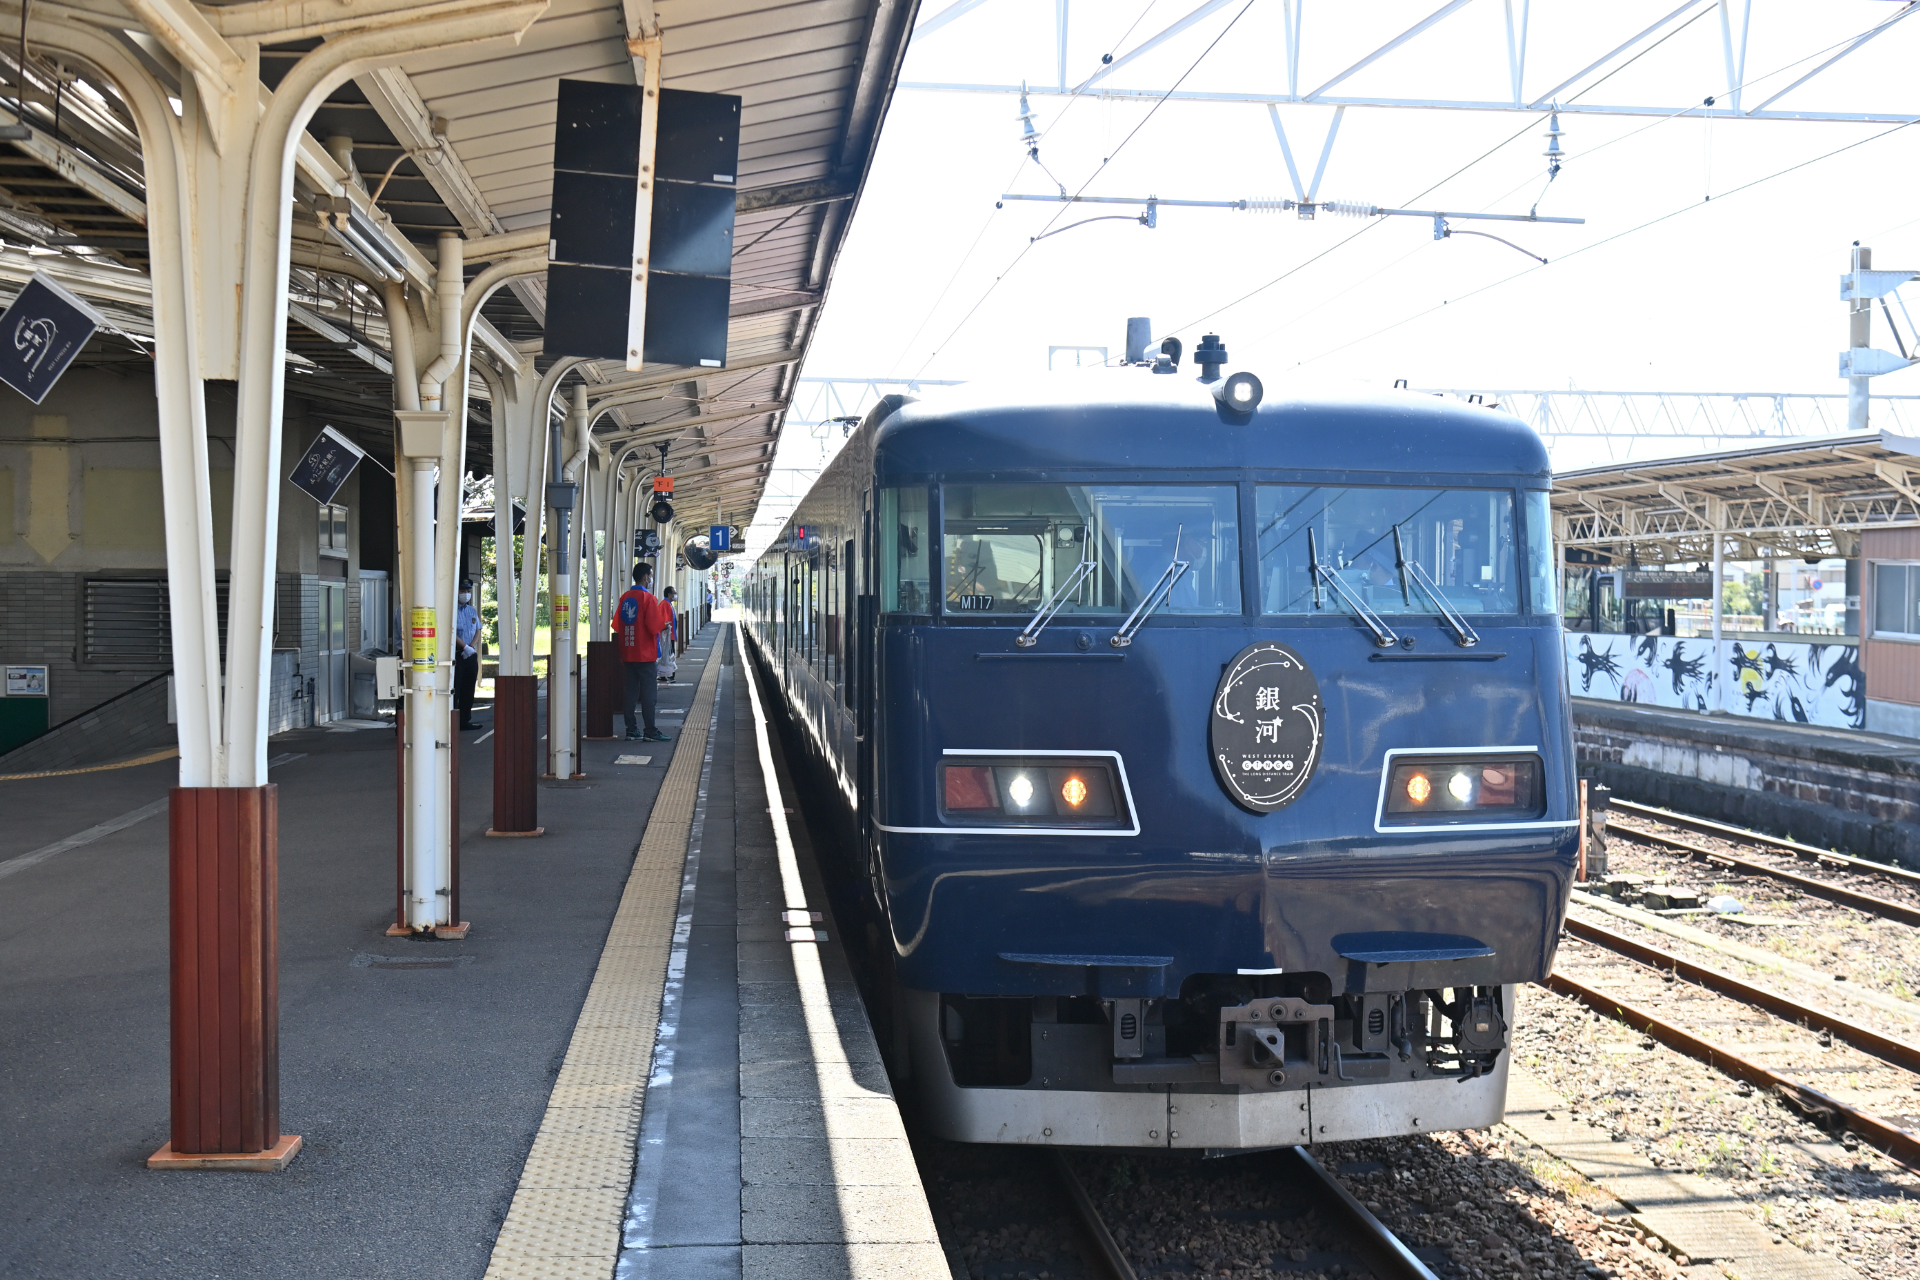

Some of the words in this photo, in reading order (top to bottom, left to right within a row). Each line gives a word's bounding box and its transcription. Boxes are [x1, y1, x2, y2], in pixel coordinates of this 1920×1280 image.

[715, 530, 723, 546] 1
[730, 528, 735, 536] 2
[961, 595, 993, 610] M117
[1255, 686, 1283, 743] 銀河
